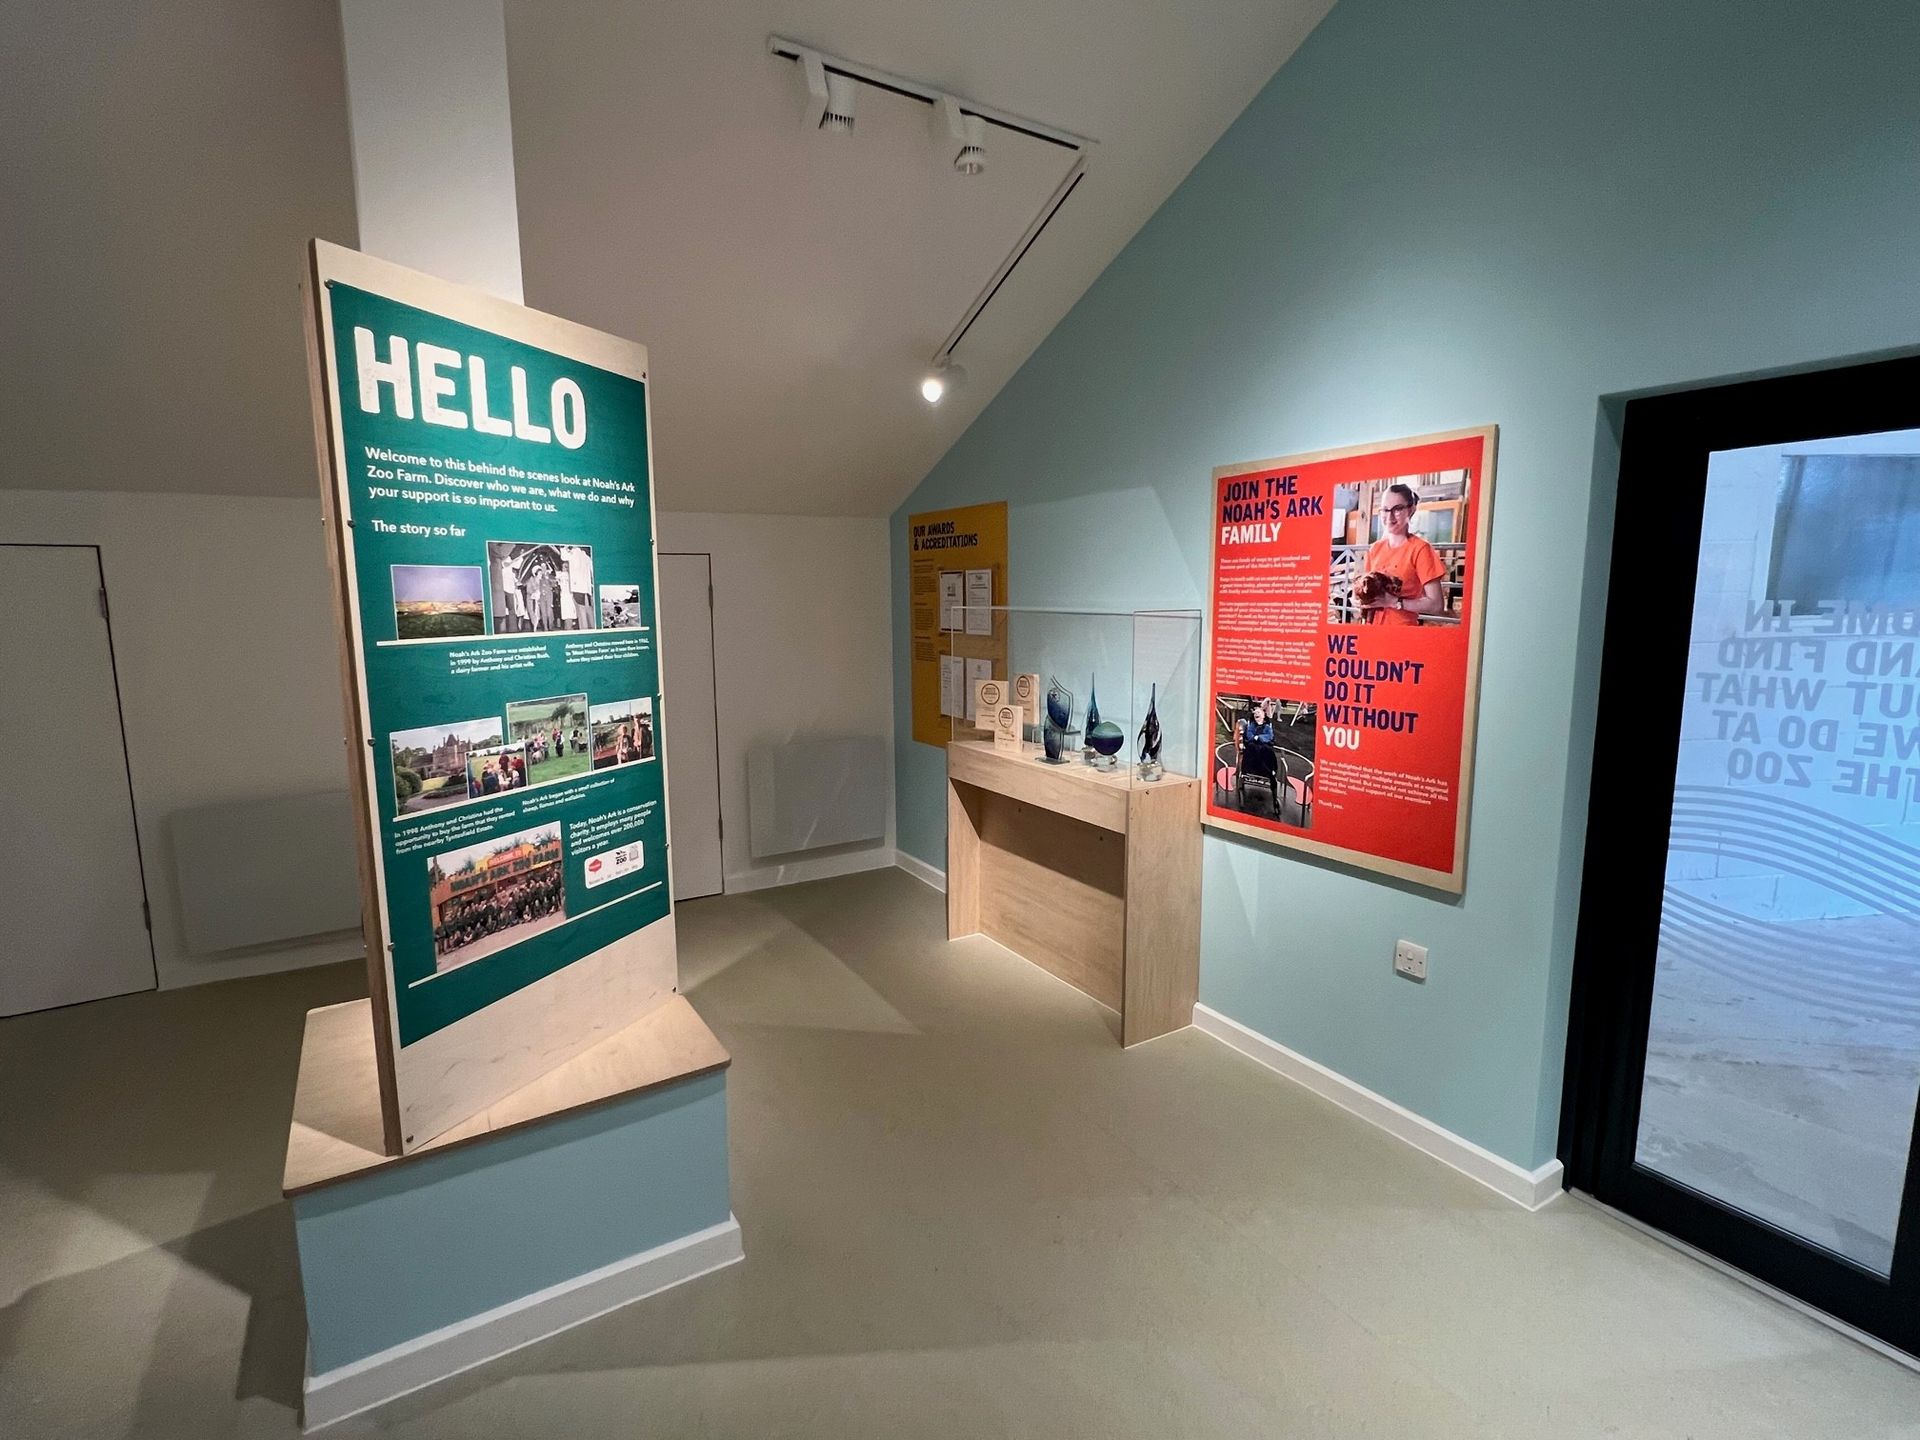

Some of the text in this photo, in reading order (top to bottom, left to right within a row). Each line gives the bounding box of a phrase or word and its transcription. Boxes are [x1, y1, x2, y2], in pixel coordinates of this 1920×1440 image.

[354, 327, 587, 450] HELLO
[364, 446, 635, 493] Welcome to this behind the scenes look at Noah's Ark
[366, 465, 635, 508] Zoo Farm. Discover who we are, what we do and why
[368, 486, 399, 499] your
[402, 489, 450, 504] support
[452, 492, 461, 503] is
[464, 495, 477, 505] so
[479, 494, 531, 510] important
[532, 501, 542, 511] to
[1224, 475, 1298, 503] JOIN THE
[1223, 495, 1323, 524] NOAH'S ARK
[371, 520, 466, 538] The story so far
[913, 522, 955, 538] OUR AWARDS
[1221, 522, 1282, 545] FAMILY
[914, 533, 978, 551] & ACCREDITATIONS
[1328, 634, 1358, 655] WE
[1326, 657, 1424, 684] COULDN'T
[1324, 680, 1375, 704] DO IT
[1324, 703, 1418, 734] WITHOUT
[1322, 726, 1360, 750] YOU
[570, 838, 582, 847] and
